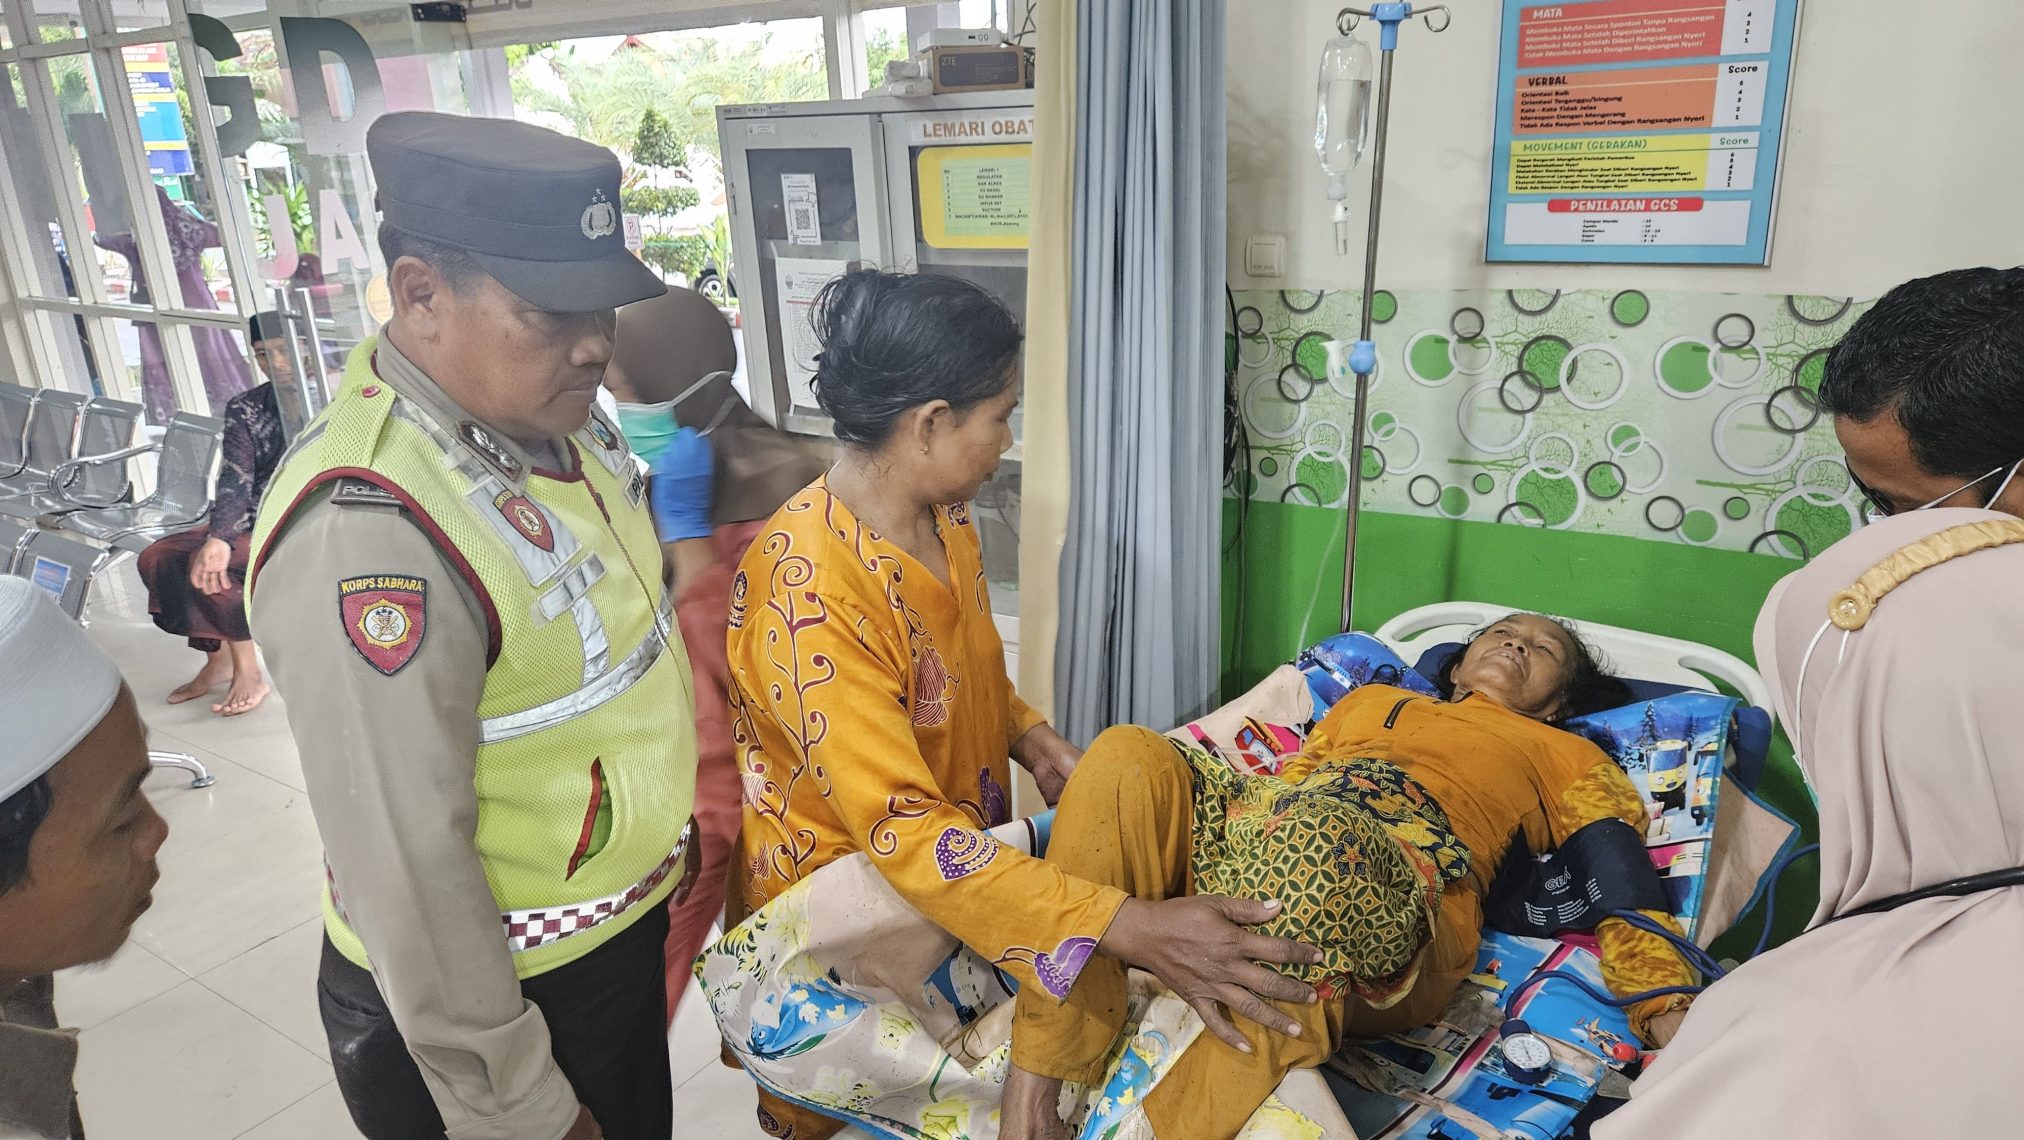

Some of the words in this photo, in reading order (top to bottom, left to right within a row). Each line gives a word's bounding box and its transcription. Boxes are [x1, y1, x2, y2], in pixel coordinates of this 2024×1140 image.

[1533, 8, 1563, 19] MATA
[1684, 32, 1706, 40] Nyeri
[1682, 41, 1703, 49] Nyeri
[941, 56, 957, 66] ZTE
[1728, 65, 1758, 74] Score
[1528, 76, 1568, 86] VERBAL
[923, 121, 985, 138] LEMARI
[1523, 142, 1583, 152] MOVEMENT
[1587, 139, 1647, 150] (GERAKAN)
[1570, 200, 1645, 211] PENILAIAN
[1650, 199, 1679, 211] GCS
[343, 486, 397, 499] POLIS
[341, 577, 375, 594] KORPS
[377, 577, 422, 591] SABHARA
